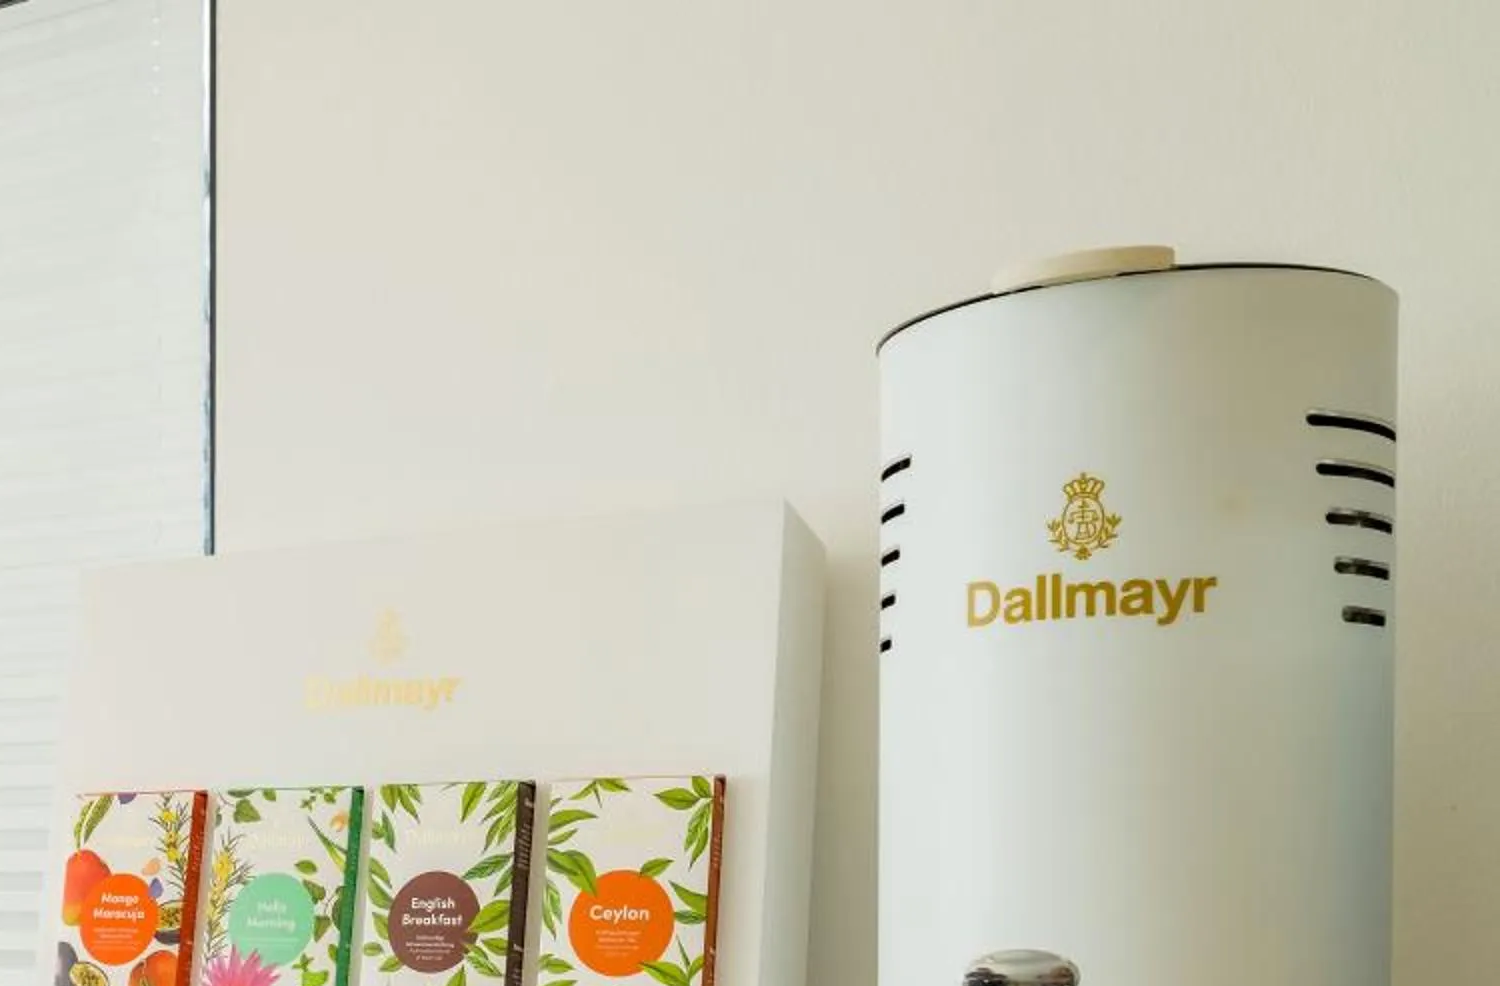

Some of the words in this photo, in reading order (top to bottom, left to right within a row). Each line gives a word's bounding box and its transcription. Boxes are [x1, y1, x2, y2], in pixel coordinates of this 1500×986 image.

[966, 573, 1219, 629] Dallmayr
[411, 897, 455, 913] English
[402, 913, 463, 926] Breakfast
[589, 904, 650, 925] Ceylon
